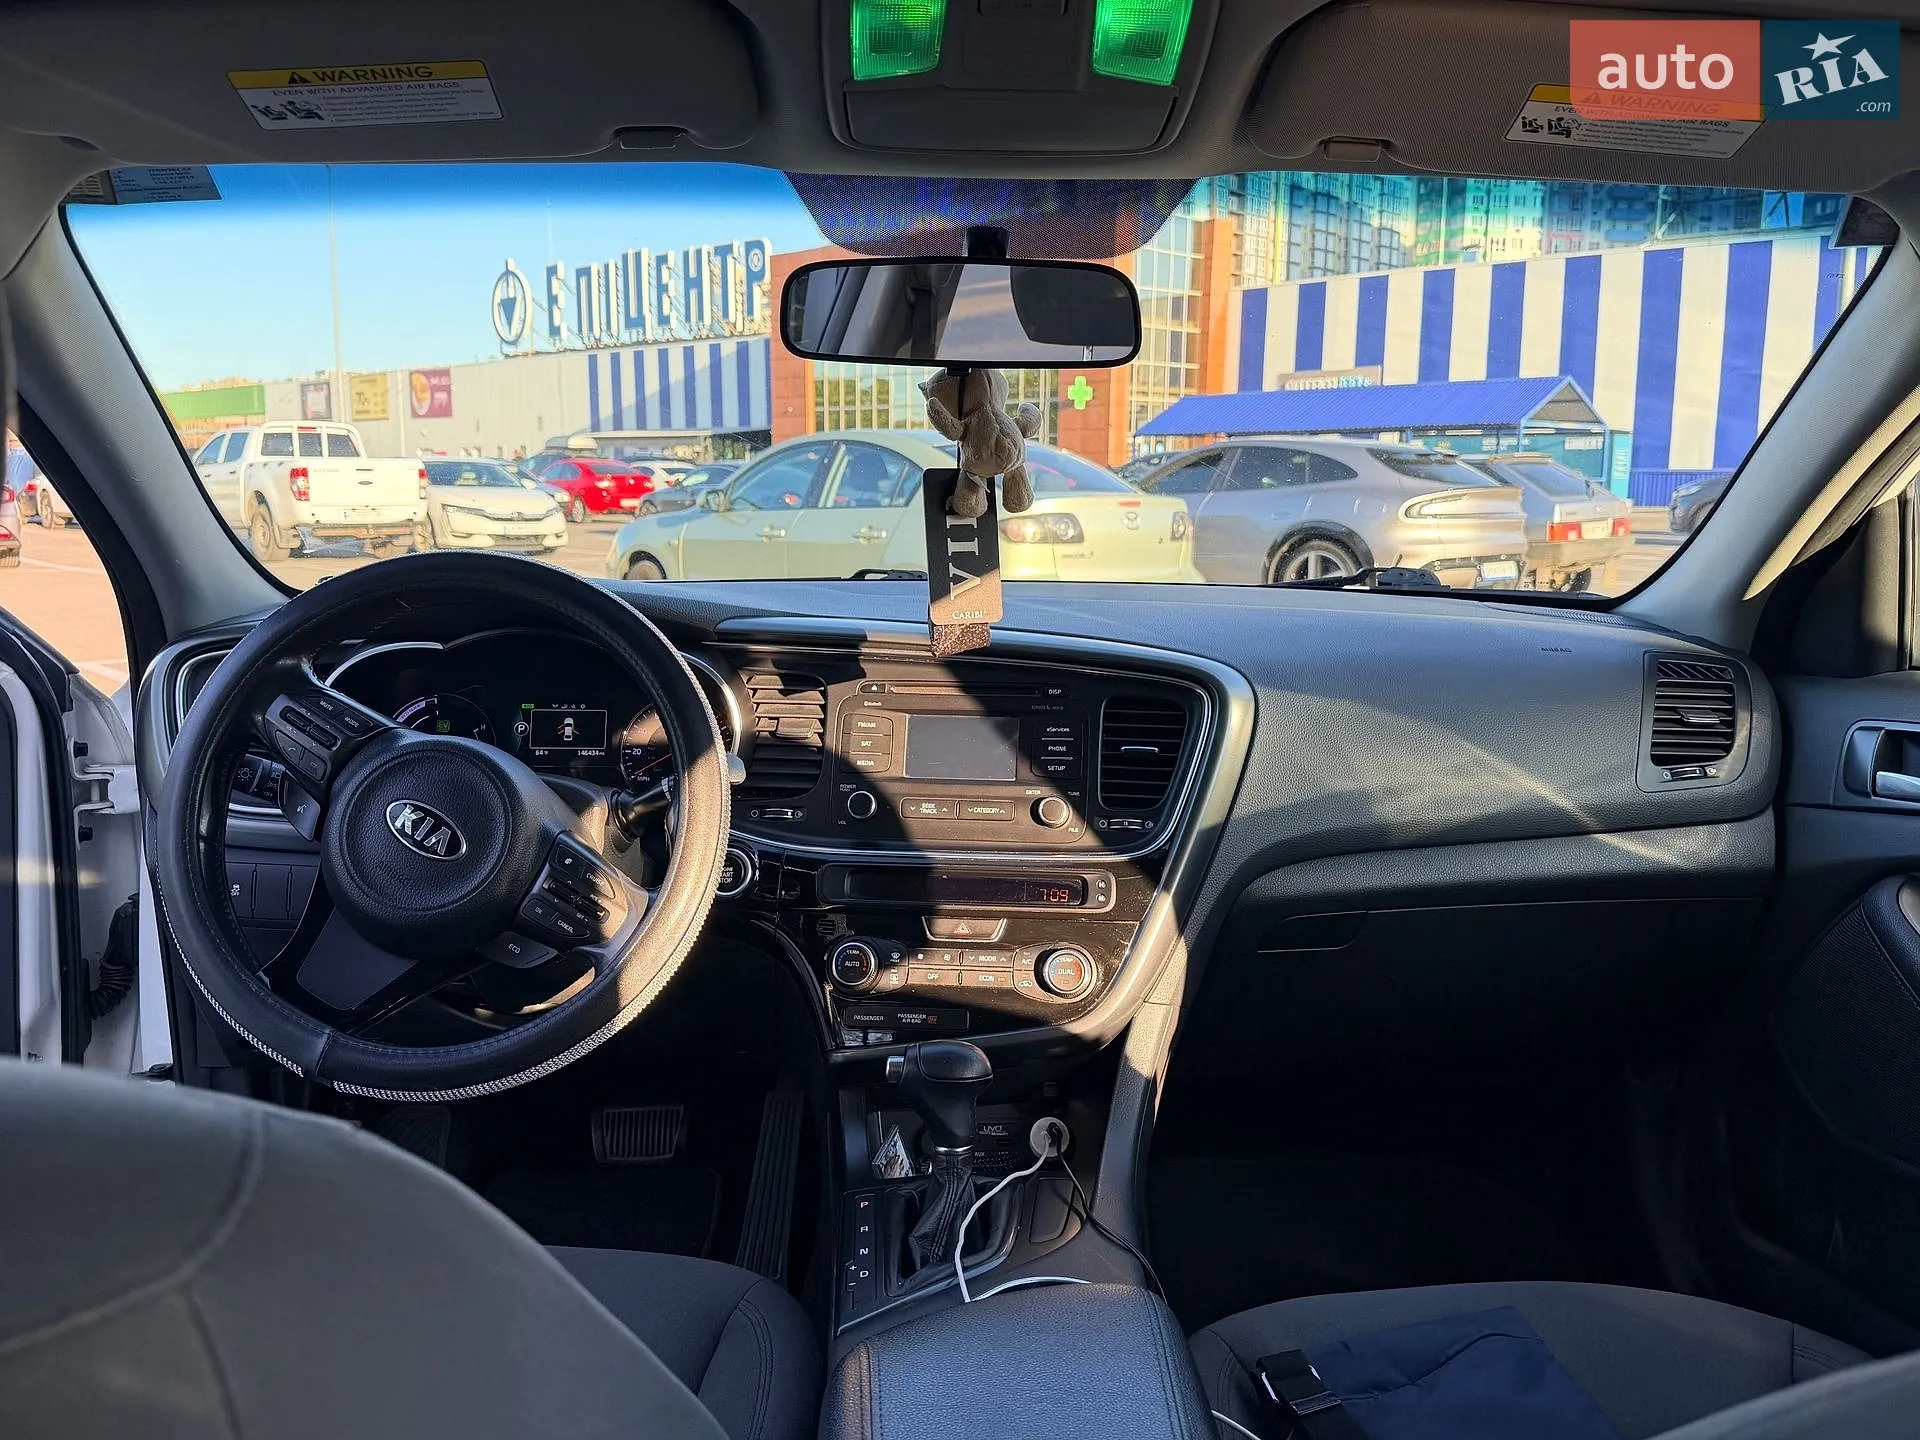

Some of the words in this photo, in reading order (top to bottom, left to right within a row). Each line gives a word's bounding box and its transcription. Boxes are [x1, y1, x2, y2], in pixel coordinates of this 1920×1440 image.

[312, 66, 434, 83] WARNING
[272, 89, 305, 97] EVEN
[306, 87, 337, 96] WITH
[340, 84, 403, 94] ADVANCED
[406, 82, 426, 91] AIR
[428, 80, 460, 90] BAGS
[1610, 93, 1721, 115] WARNING
[319, 700, 334, 711] MUTE
[344, 716, 360, 729] MODE
[632, 748, 642, 756] 20
[856, 759, 875, 767] MEDIA
[394, 804, 452, 855] KIA
[585, 872, 606, 887] CRUISE
[557, 919, 574, 934] CANCEL
[507, 943, 521, 954] ECO
[860, 1201, 869, 1209] P
[859, 1247, 869, 1256] N
[859, 1269, 869, 1278] D
